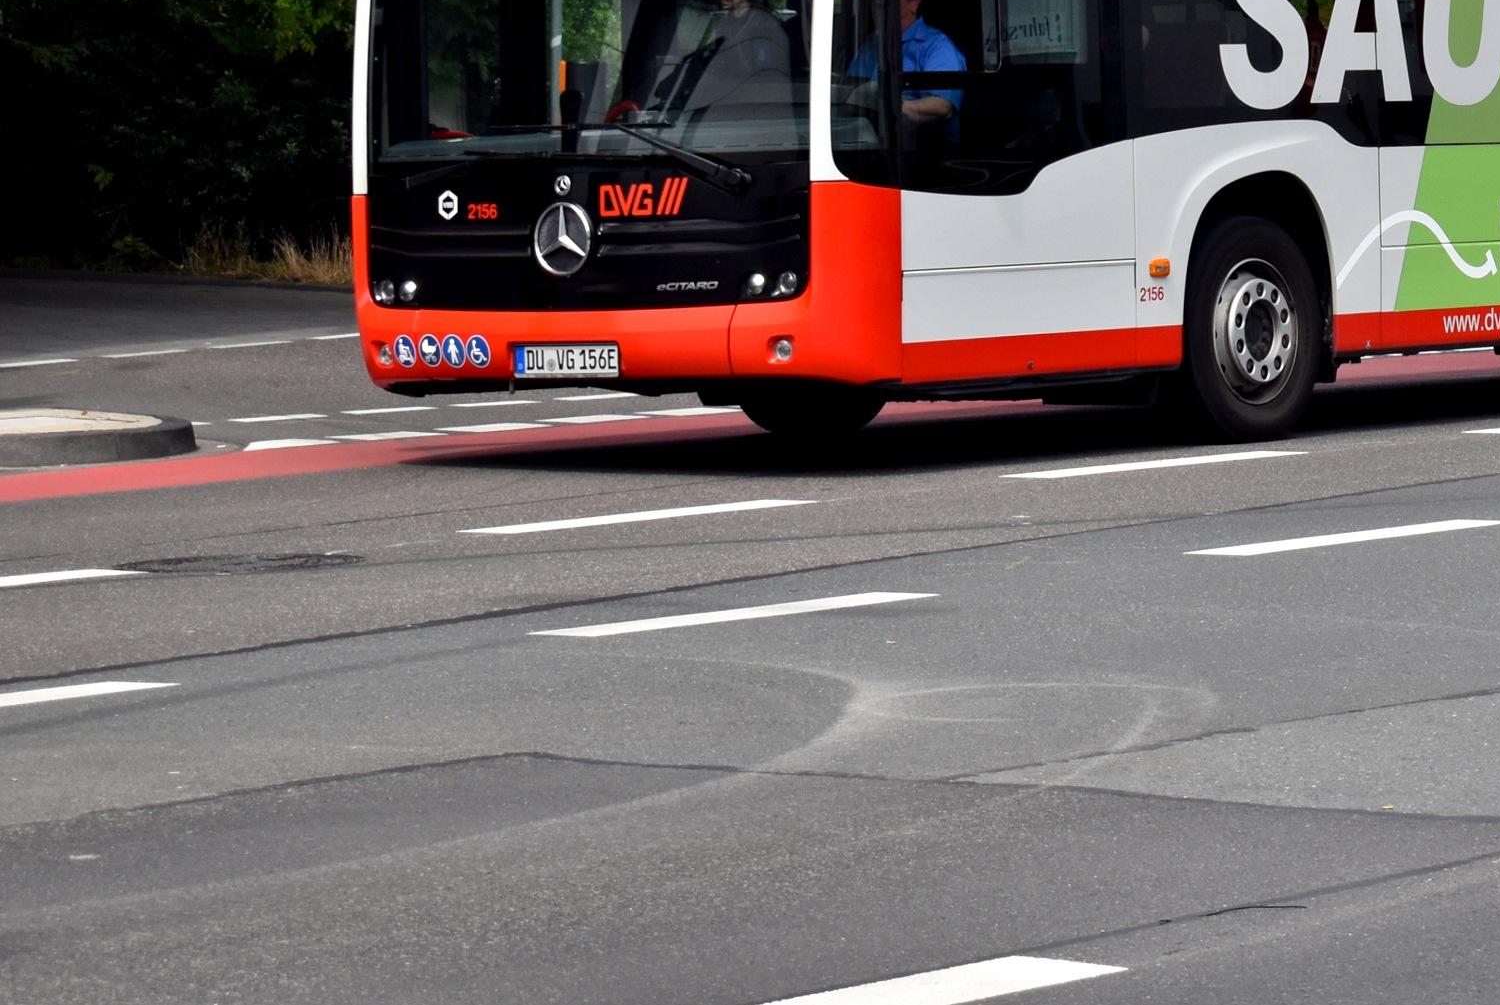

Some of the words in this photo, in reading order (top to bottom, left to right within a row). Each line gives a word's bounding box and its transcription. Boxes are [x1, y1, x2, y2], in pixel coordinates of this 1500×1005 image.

[467, 202, 499, 220] 2156
[1140, 286, 1165, 302] 2156
[526, 349, 545, 371] DU
[556, 349, 575, 371] VG
[579, 348, 617, 371] 156E
